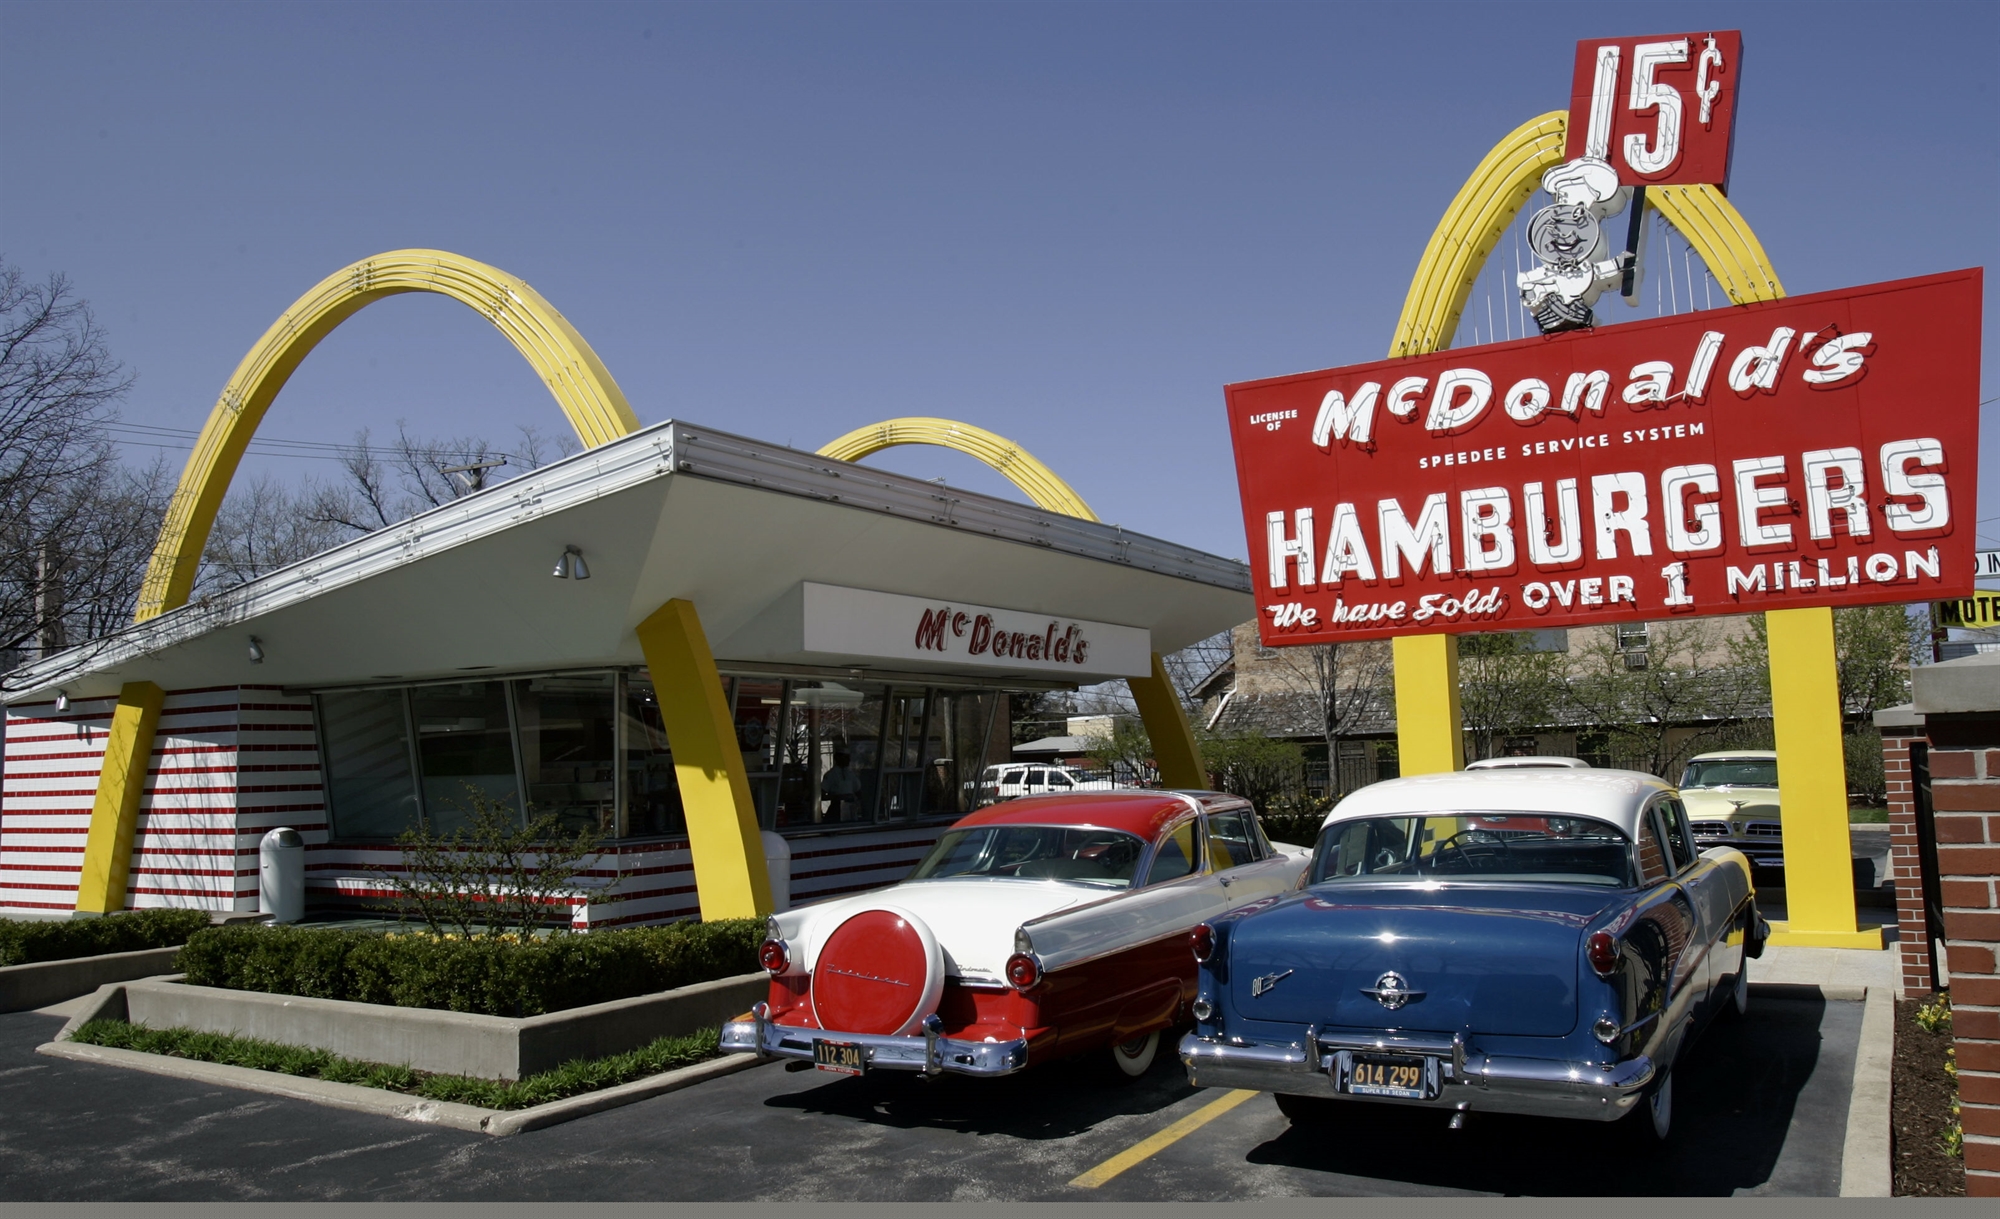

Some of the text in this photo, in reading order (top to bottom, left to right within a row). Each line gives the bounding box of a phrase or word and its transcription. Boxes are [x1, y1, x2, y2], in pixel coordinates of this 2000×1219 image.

[1312, 326, 1873, 447] McDonald's
[1250, 409, 1298, 425] LICENSEE
[1266, 421, 1281, 431] OF
[1419, 422, 1704, 469] SPEEDEE SERVICE SYSTEM
[1266, 437, 1950, 589] HAMBURGERS
[1268, 602, 1317, 627] We
[1331, 597, 1406, 623] have
[1522, 575, 1636, 609] OVER
[1660, 562, 1694, 606] 1
[1726, 546, 1940, 595] MILLION
[915, 607, 1091, 665] McDonald's
[818, 1045, 860, 1066] 112 304
[1355, 1063, 1419, 1087] 614 299
